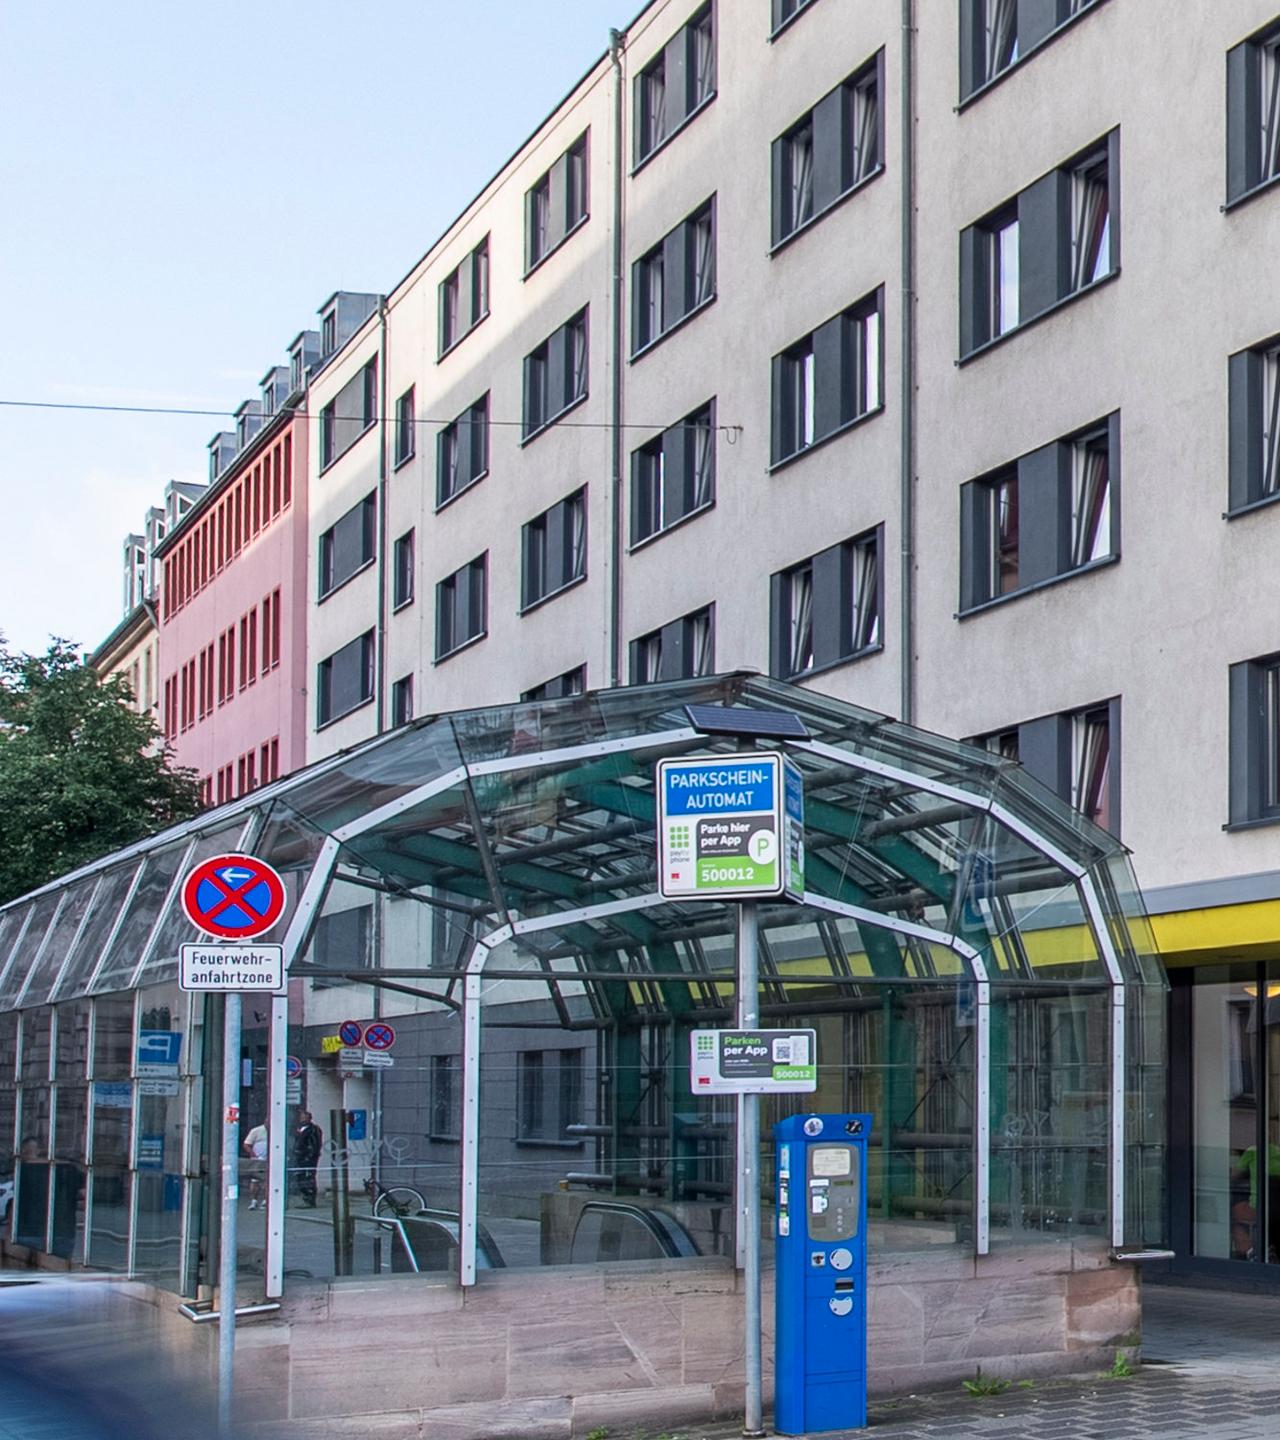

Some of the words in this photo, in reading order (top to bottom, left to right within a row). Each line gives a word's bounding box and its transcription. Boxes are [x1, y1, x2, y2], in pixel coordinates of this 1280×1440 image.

[670, 769, 769, 788] PARKSCHEIN-
[686, 791, 754, 809] AUTOMAT
[700, 823, 728, 834] Parke
[730, 821, 750, 832] hier
[701, 837, 718, 848] per
[720, 835, 742, 847] App
[702, 868, 754, 882] 500012
[192, 951, 272, 965] Feuerwehr-
[192, 970, 273, 983] anfahrtzone
[724, 1037, 761, 1045] Parken
[724, 1047, 742, 1056] per
[745, 1046, 768, 1056] App
[776, 1071, 810, 1079] 500012
